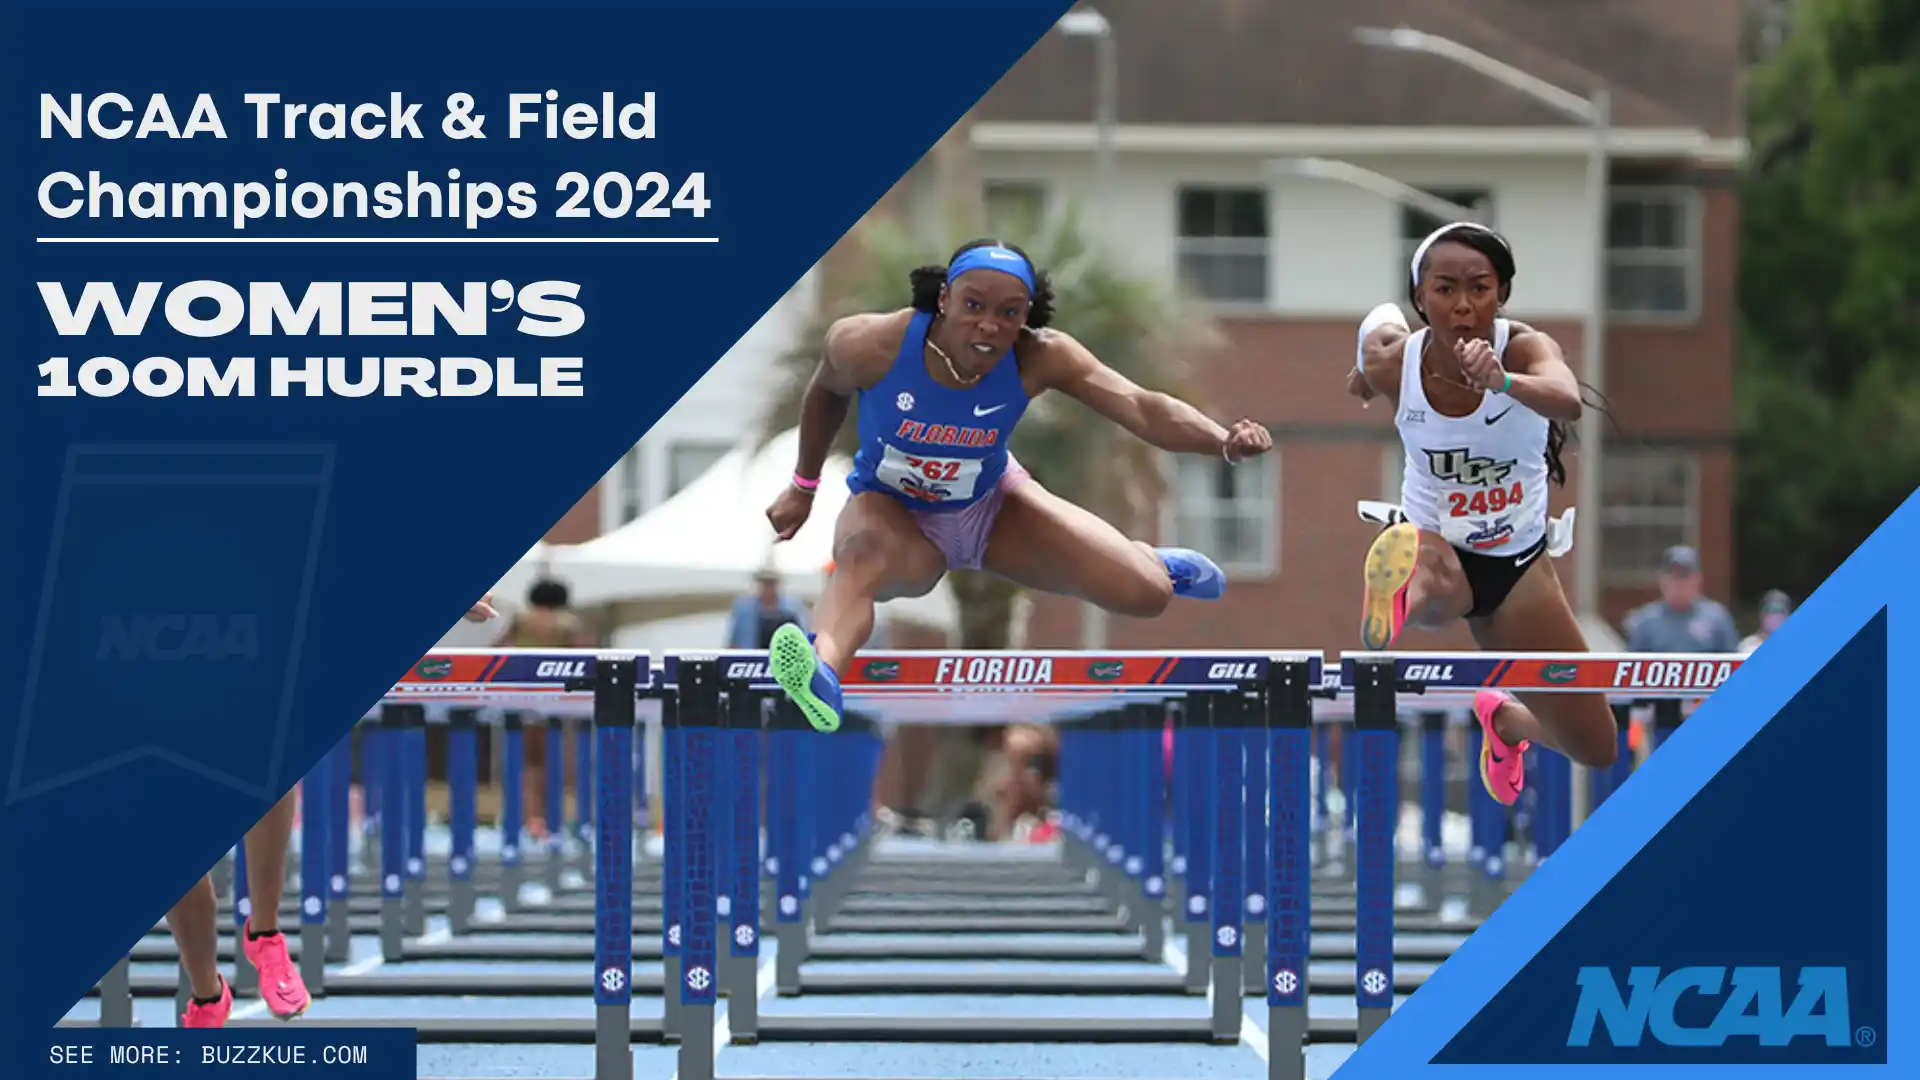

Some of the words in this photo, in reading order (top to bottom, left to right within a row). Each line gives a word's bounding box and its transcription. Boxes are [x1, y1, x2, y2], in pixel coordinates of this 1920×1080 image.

[896, 419, 999, 448] FLORIDA
[1421, 447, 1518, 487] UCF
[1448, 481, 1524, 518] 2494
[536, 661, 586, 678] GILL
[935, 658, 1054, 685] FLORIDA
[1207, 662, 1258, 680] GILL
[1404, 664, 1454, 681] GILL
[1612, 661, 1732, 688] FLORIDA
